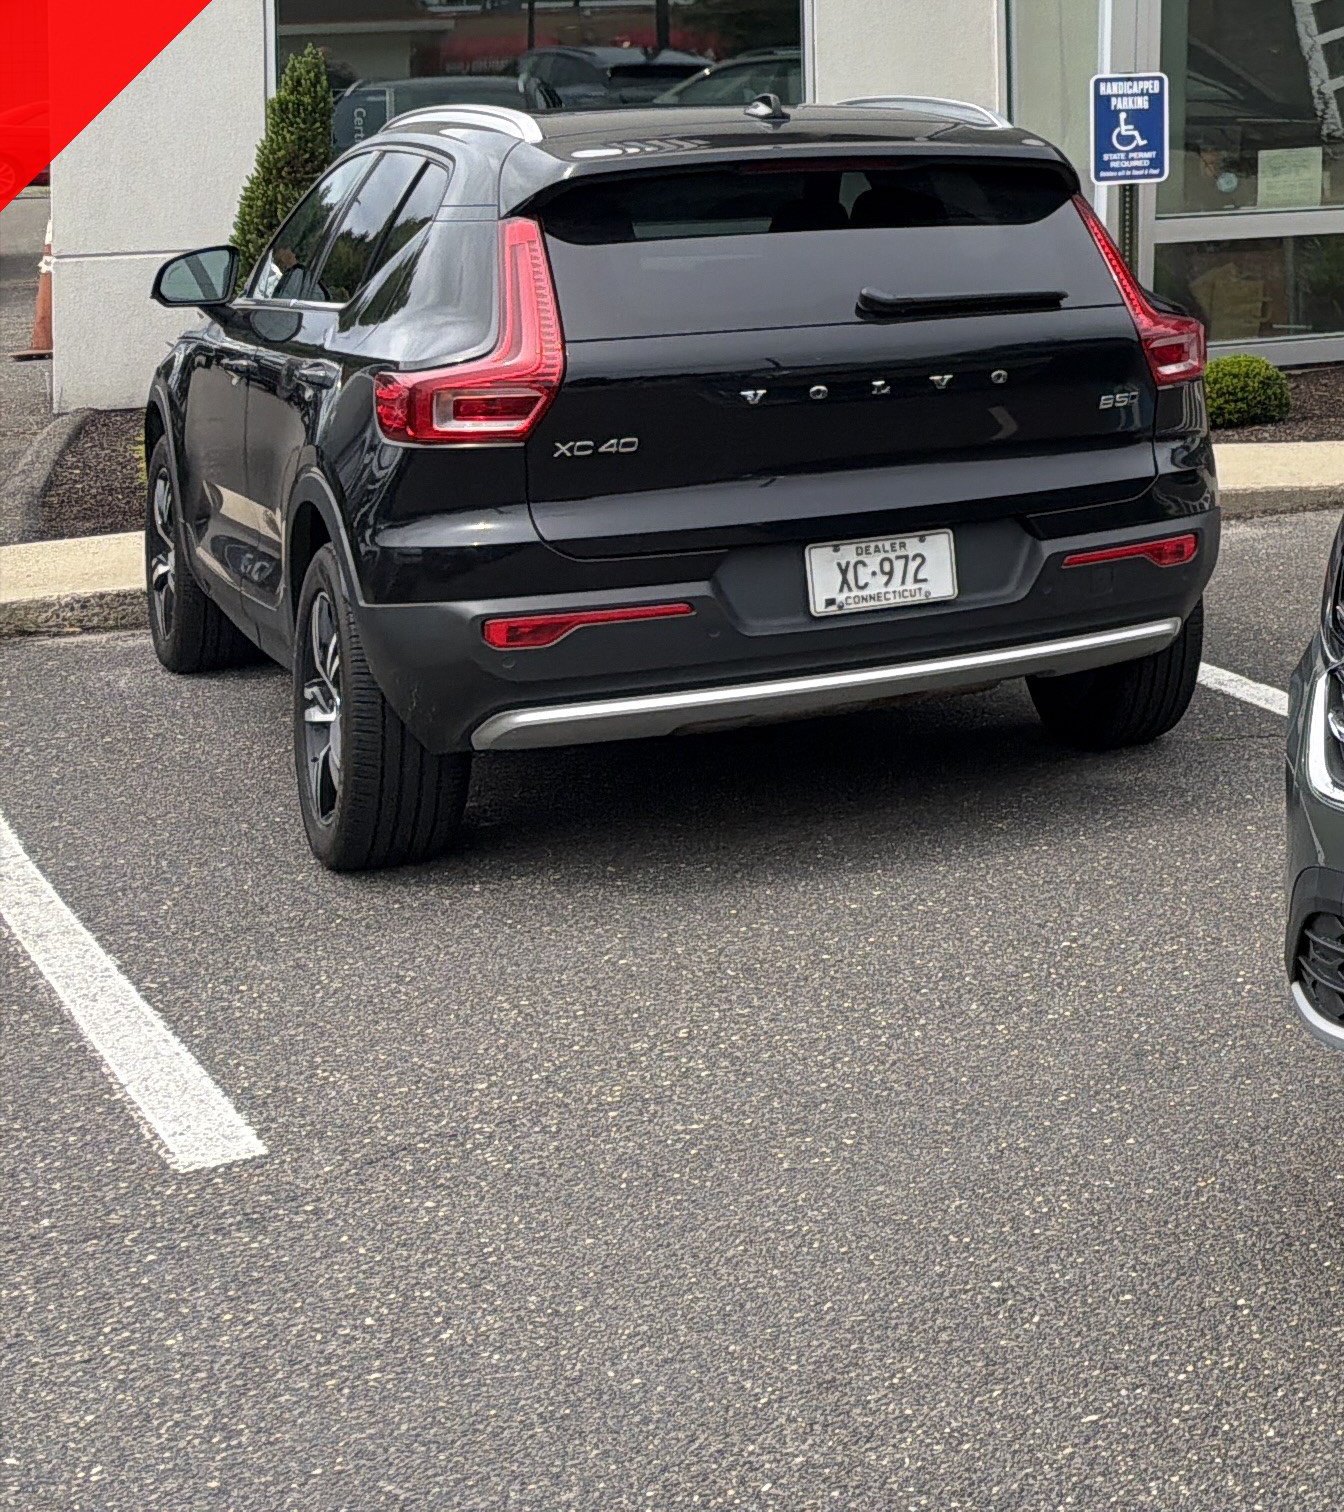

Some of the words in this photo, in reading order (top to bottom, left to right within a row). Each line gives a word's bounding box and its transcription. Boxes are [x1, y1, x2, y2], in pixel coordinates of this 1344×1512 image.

[1100, 79, 1160, 95] HANDICAPPED
[1111, 95, 1149, 110] PARKING
[1103, 152, 1126, 161] STATE
[739, 369, 1009, 405] VOLVO
[855, 541, 907, 557] DEALER
[844, 587, 923, 606] CONNECTICUT
